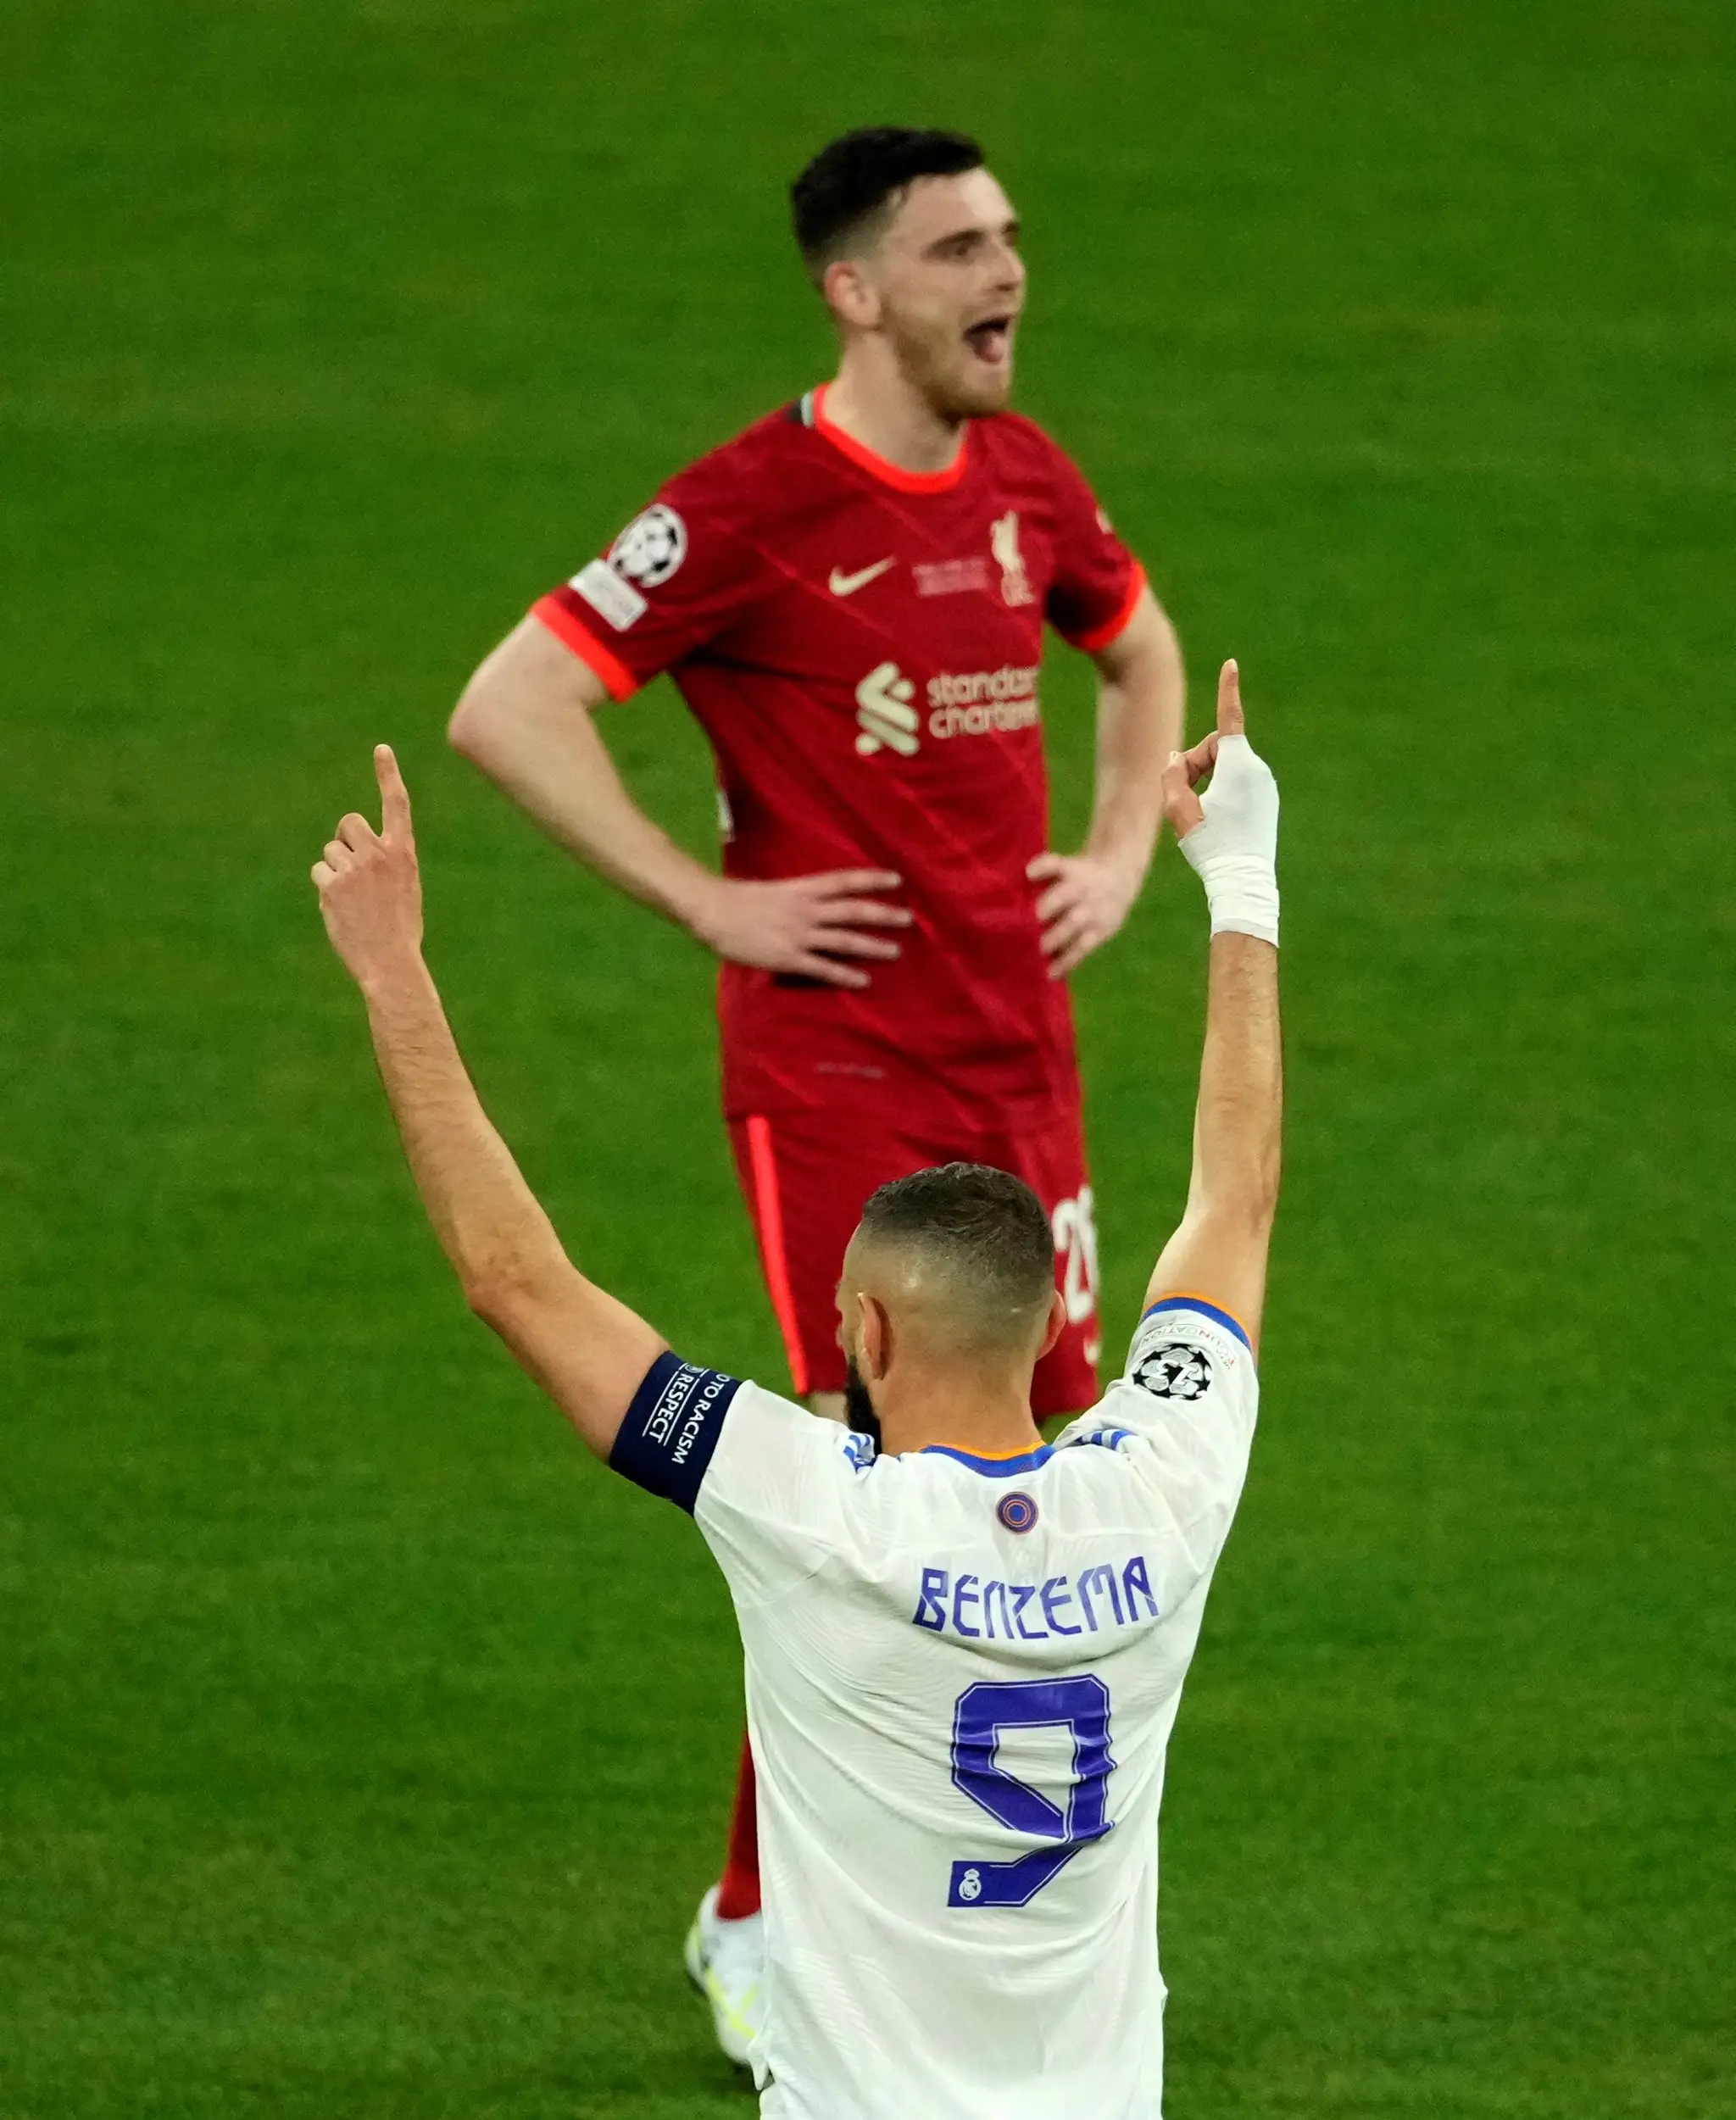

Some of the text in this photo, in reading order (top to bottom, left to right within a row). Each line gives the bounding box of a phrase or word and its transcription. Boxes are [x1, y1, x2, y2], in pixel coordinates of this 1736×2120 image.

[648, 1373, 696, 1444] RESPECT
[704, 1381, 725, 1399] TO
[670, 1399, 712, 1465] RACISM
[912, 1555, 1159, 1640] BENZEMA
[947, 1672, 1117, 1908] 9
